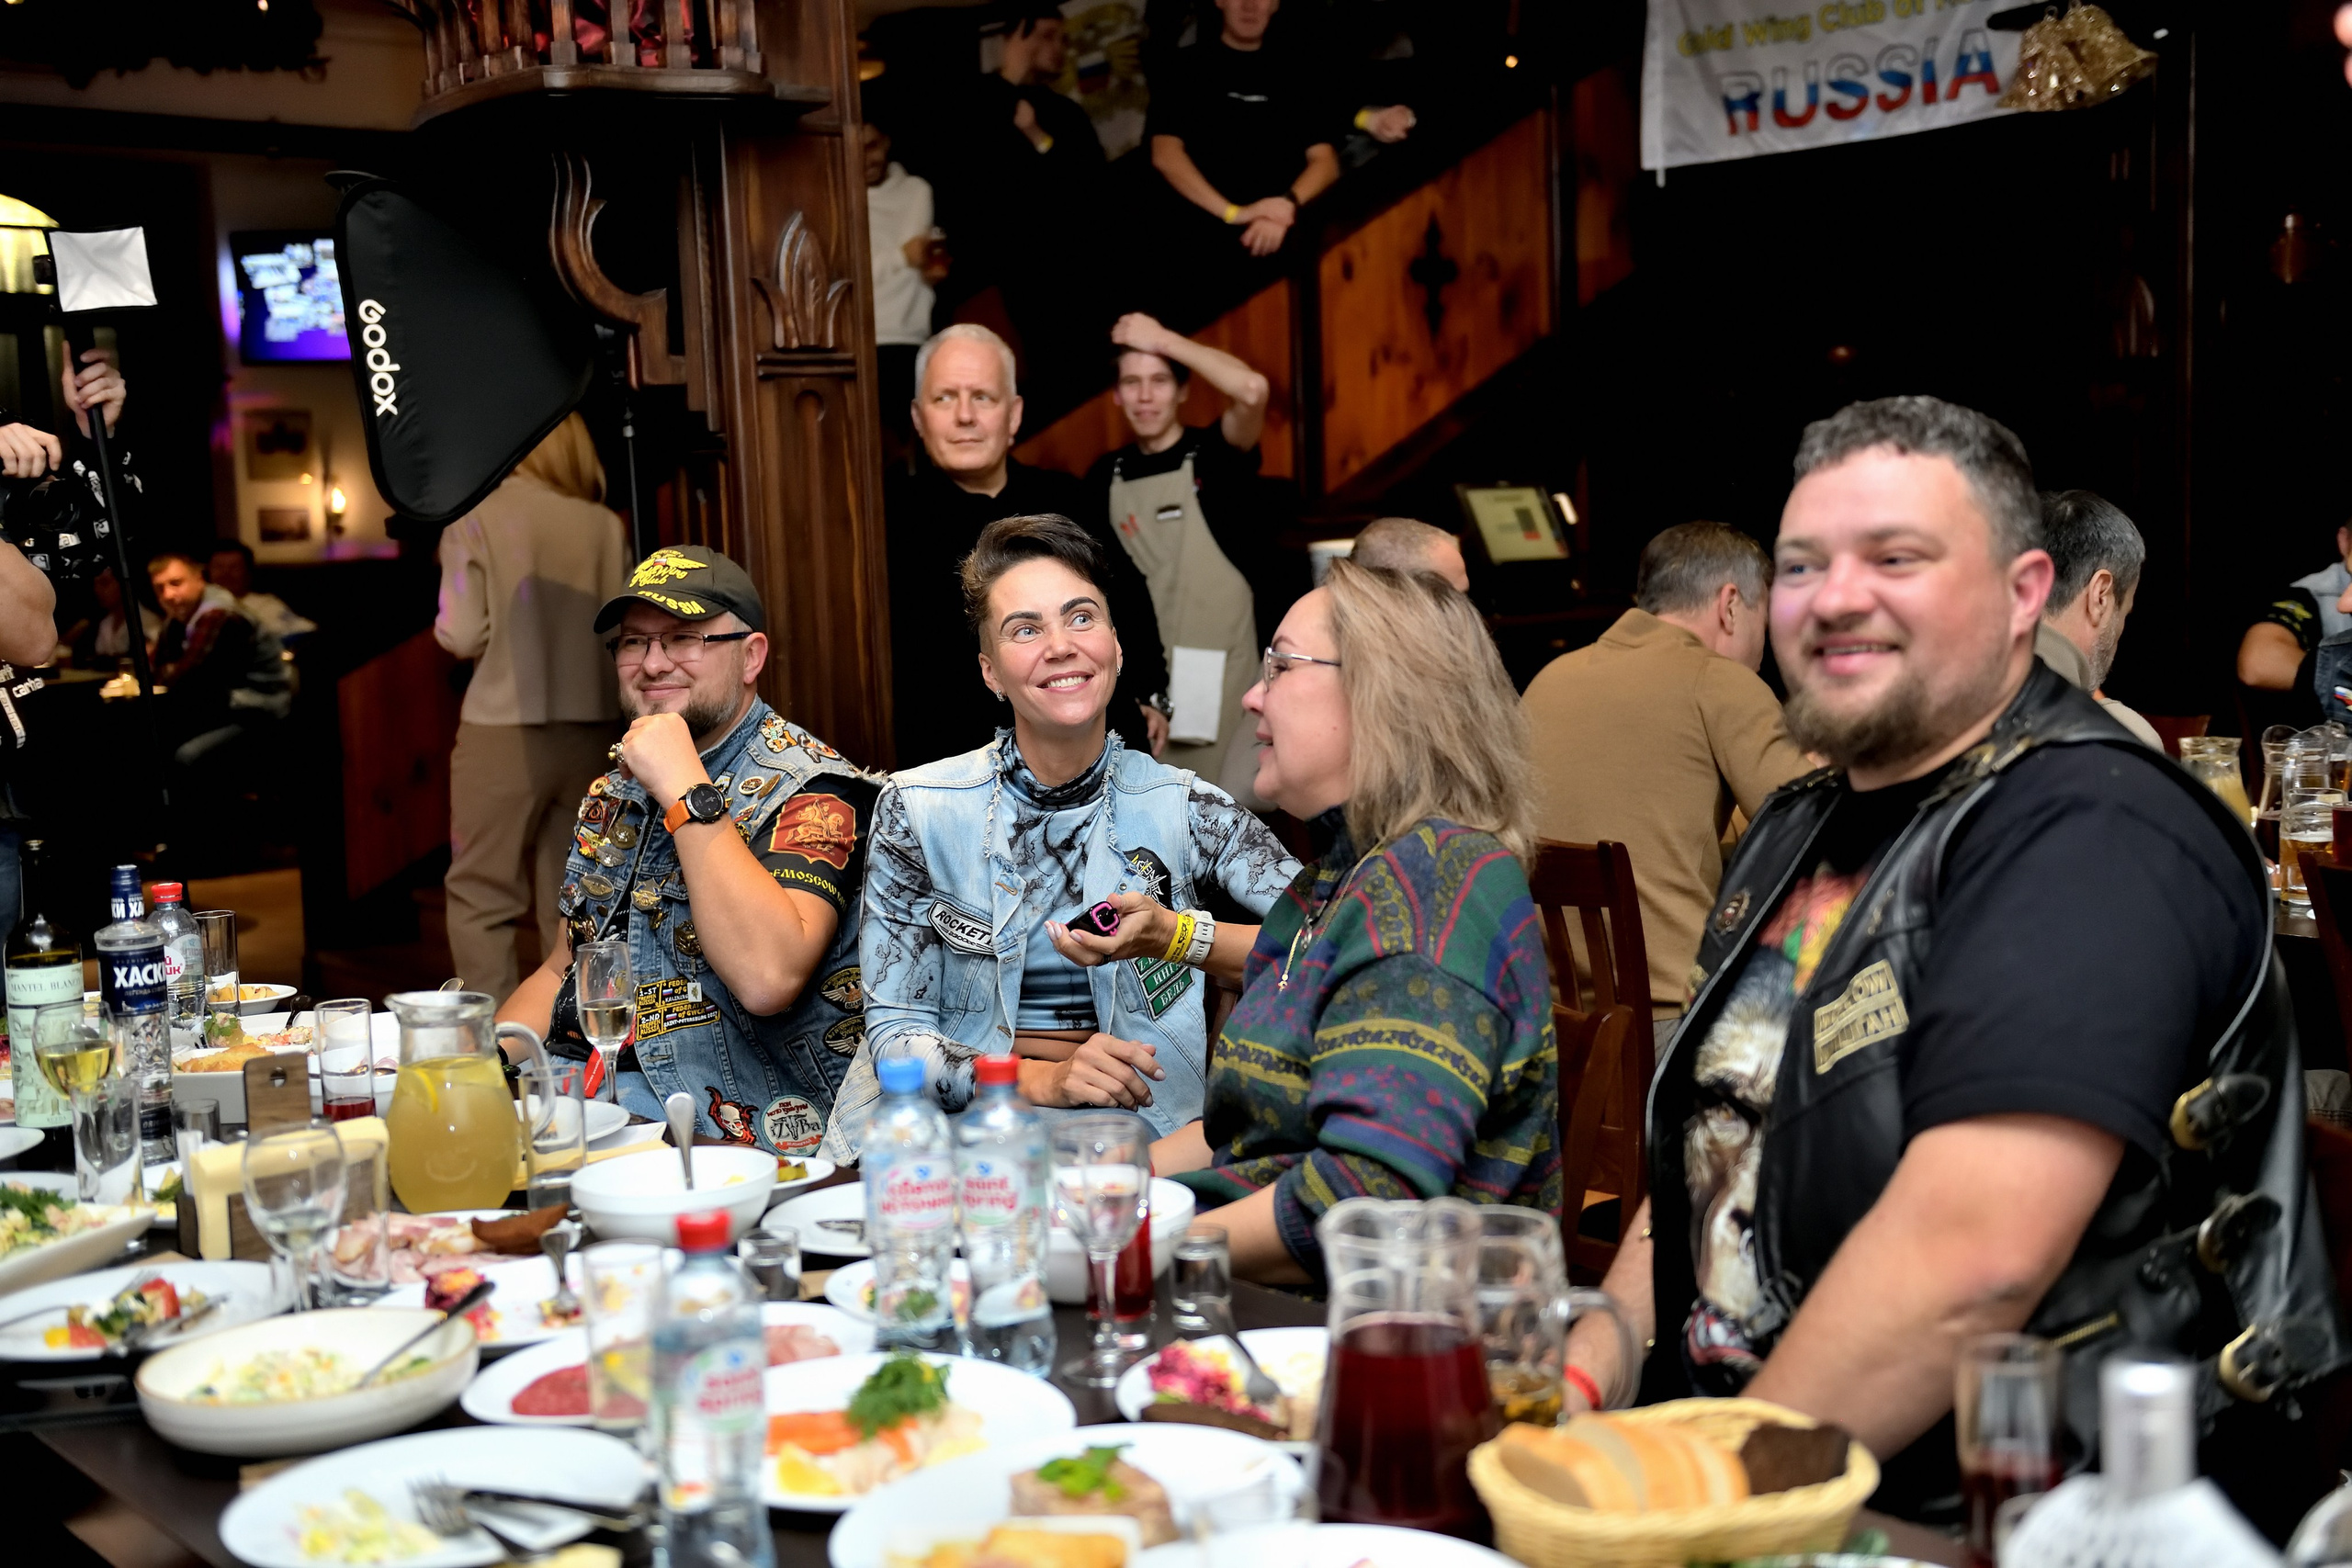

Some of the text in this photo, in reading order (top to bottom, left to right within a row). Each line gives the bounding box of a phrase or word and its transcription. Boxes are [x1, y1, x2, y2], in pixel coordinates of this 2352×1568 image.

[1818, 0, 1884, 32] Club
[1719, 28, 2001, 135] RUSSIA
[637, 590, 706, 615] RUSSIA
[780, 868, 837, 895] MOSCOW
[8, 983, 46, 992] MANTEL
[639, 987, 657, 997] 1-ST
[1159, 979, 1184, 1006] БЕЛЬ
[641, 1013, 661, 1024] 2-ND
[672, 999, 711, 1013] FEDERATION
